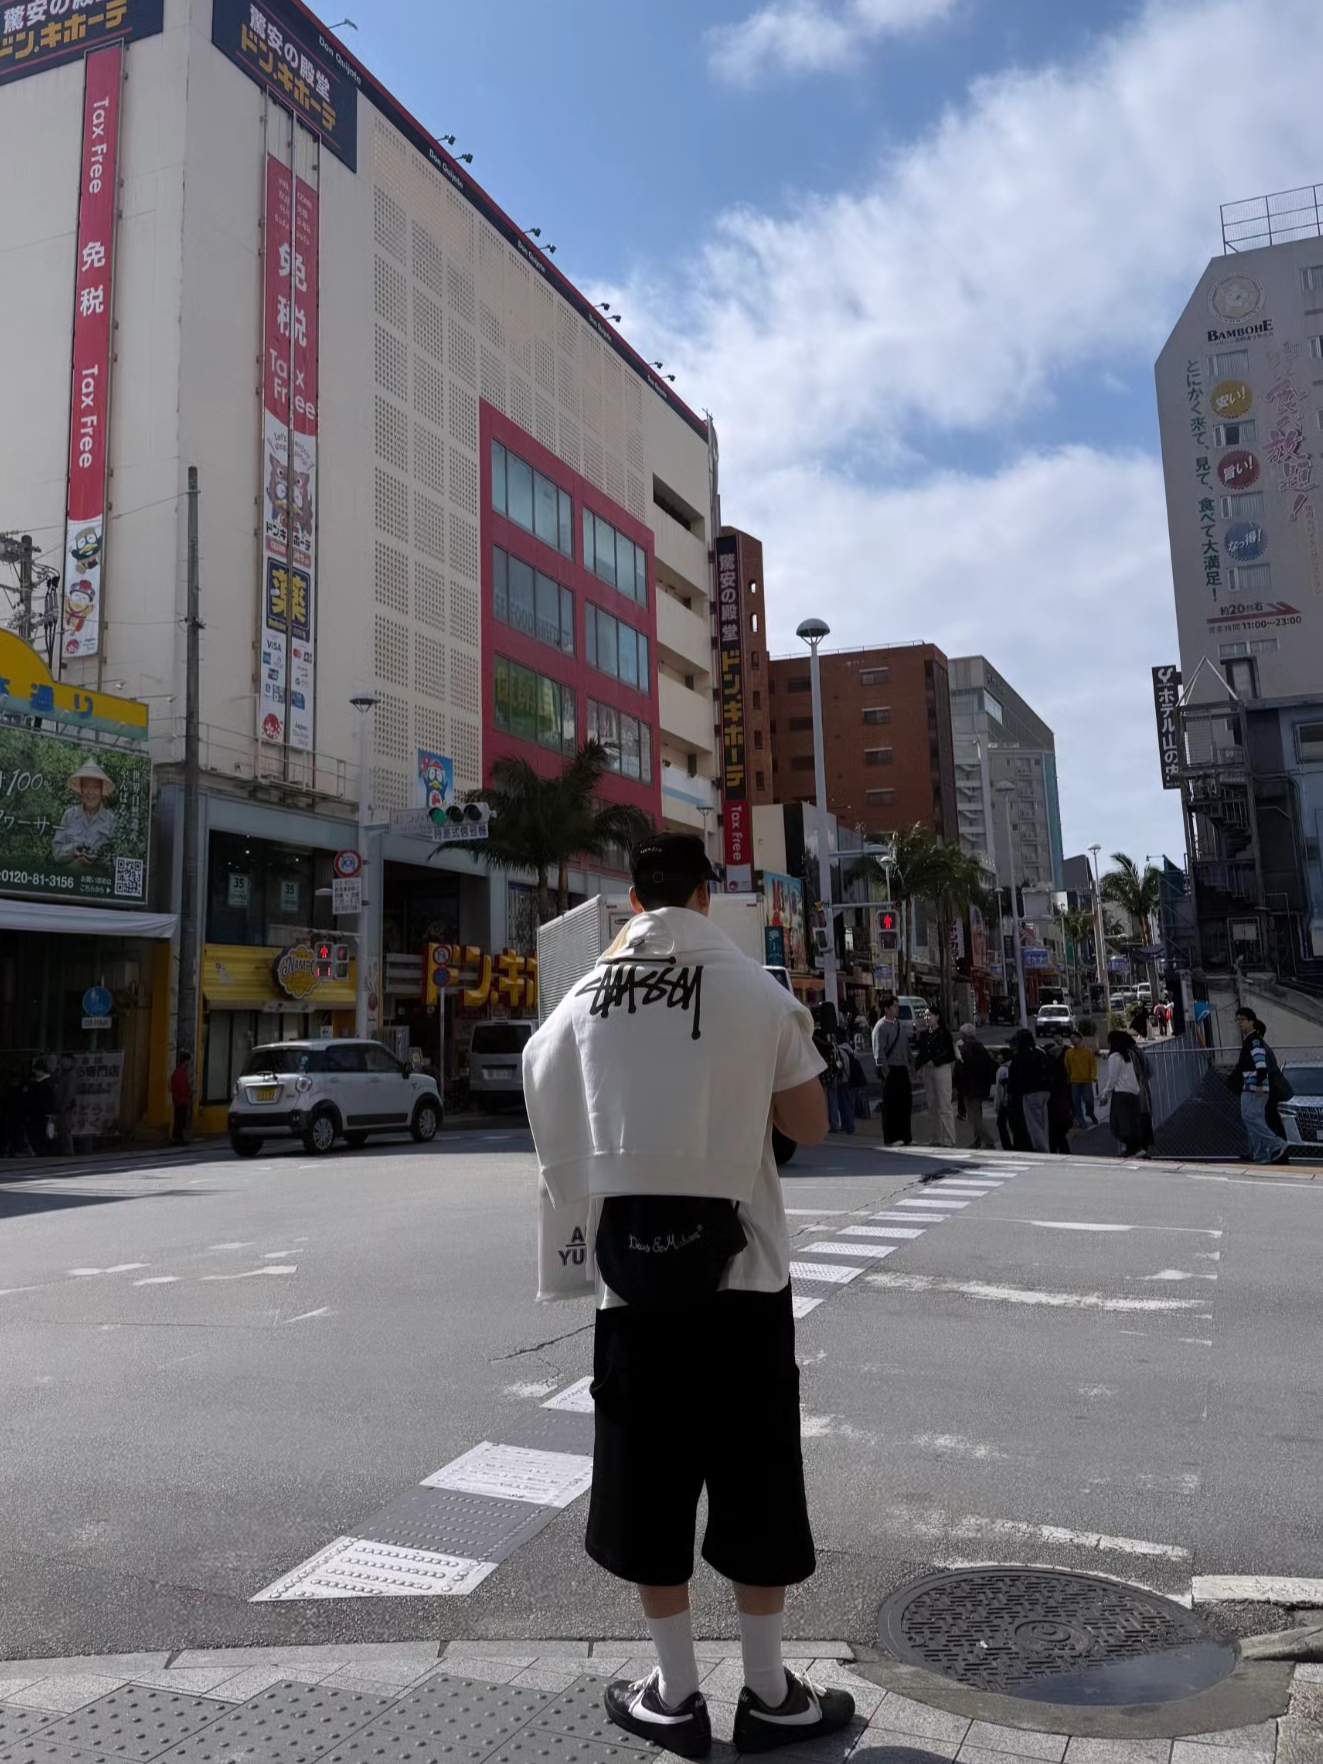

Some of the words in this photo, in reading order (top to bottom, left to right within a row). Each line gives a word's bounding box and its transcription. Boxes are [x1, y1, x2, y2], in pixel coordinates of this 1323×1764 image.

[248, 3, 331, 104] 驚安の殿堂
[319, 35, 334, 58] Don
[335, 52, 362, 86] Quijote
[92, 96, 109, 139] Tax
[89, 143, 107, 195] Free
[80, 241, 105, 317] 免税
[1207, 319, 1274, 342] BAMBOHE
[269, 348, 305, 390] Tax
[81, 365, 98, 407] Tax
[273, 377, 315, 420] Free
[79, 415, 97, 468] Free
[1222, 456, 1255, 482] 旨い!
[1228, 528, 1262, 549] なっ得!
[719, 553, 739, 642] 驚安の殿堂
[267, 638, 282, 652] VISA
[433, 825, 488, 840] 時差式信号機
[730, 805, 742, 833] Tax
[732, 835, 744, 863] Free
[233, 877, 245, 889] 35
[284, 883, 295, 895] 35
[571, 1226, 585, 1243] A
[629, 1233, 651, 1253] Deus
[558, 1248, 586, 1267] YU
